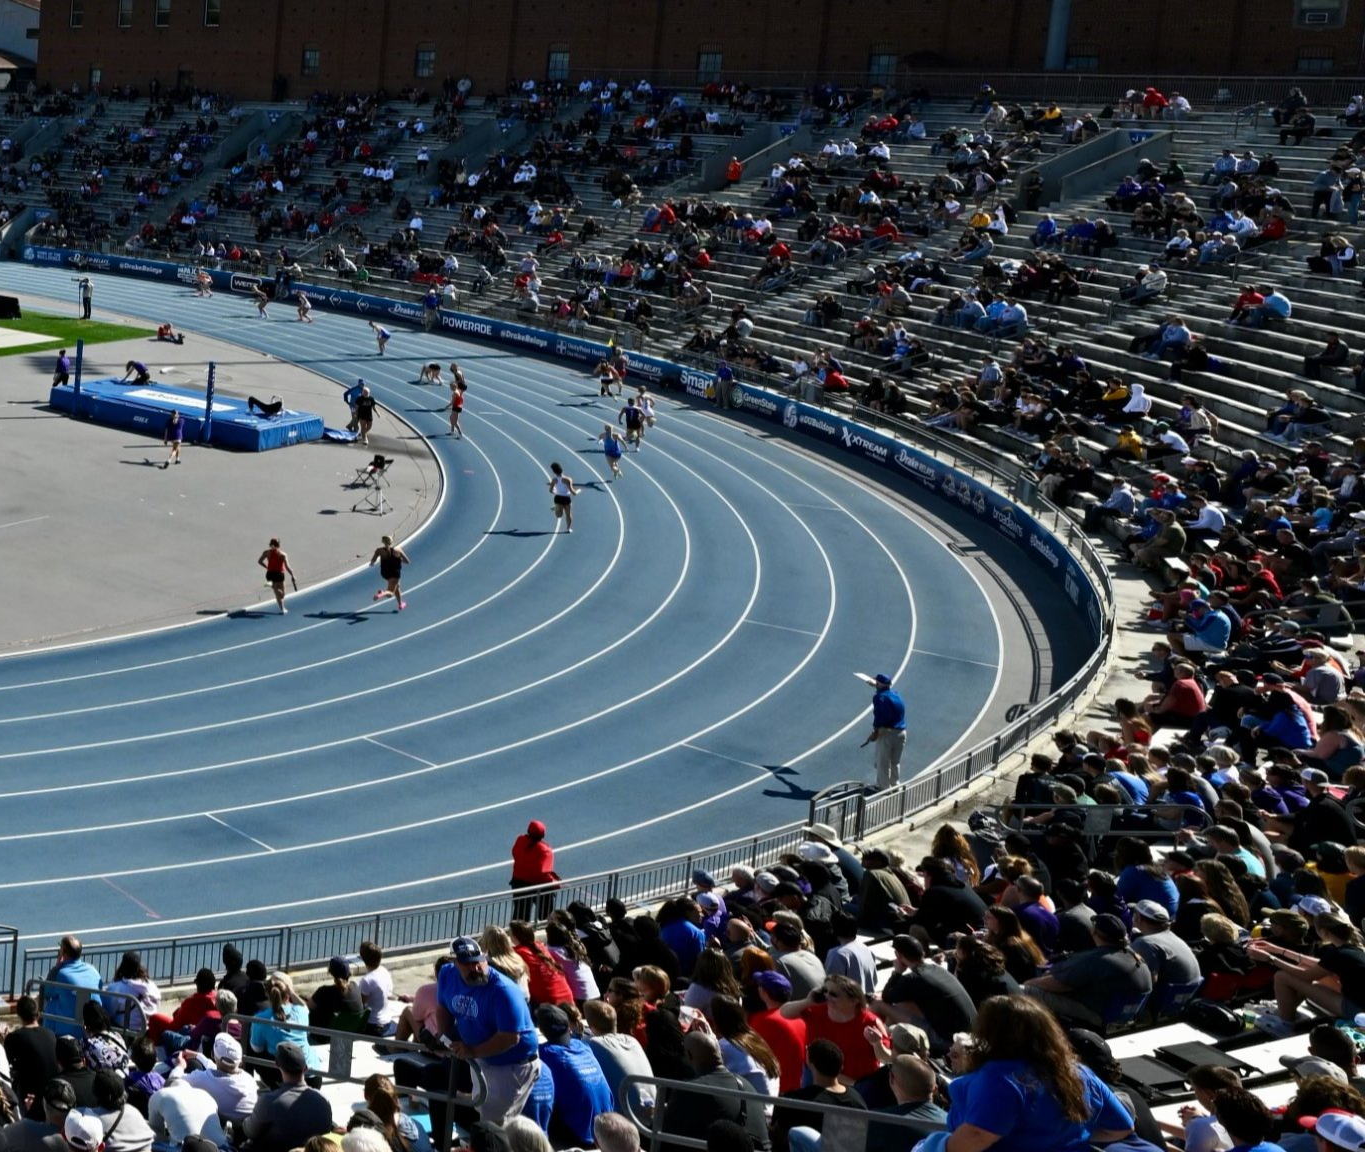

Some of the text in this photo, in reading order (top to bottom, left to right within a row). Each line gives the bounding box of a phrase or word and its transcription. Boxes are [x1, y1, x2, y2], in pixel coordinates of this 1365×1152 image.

[119, 262, 163, 275] @DrakeRelays
[393, 303, 416, 316] Drake
[442, 316, 492, 335] POWERADE
[500, 329, 548, 348] @DrakeRelays
[567, 342, 607, 358] UnityPoint Health
[643, 363, 662, 374] RELAYS
[680, 370, 714, 390] Smart
[743, 392, 778, 411] GreenState
[799, 414, 835, 435] @DUBulldogs
[851, 434, 888, 457] XTREAM
[899, 448, 936, 479] Drake RELAYS
